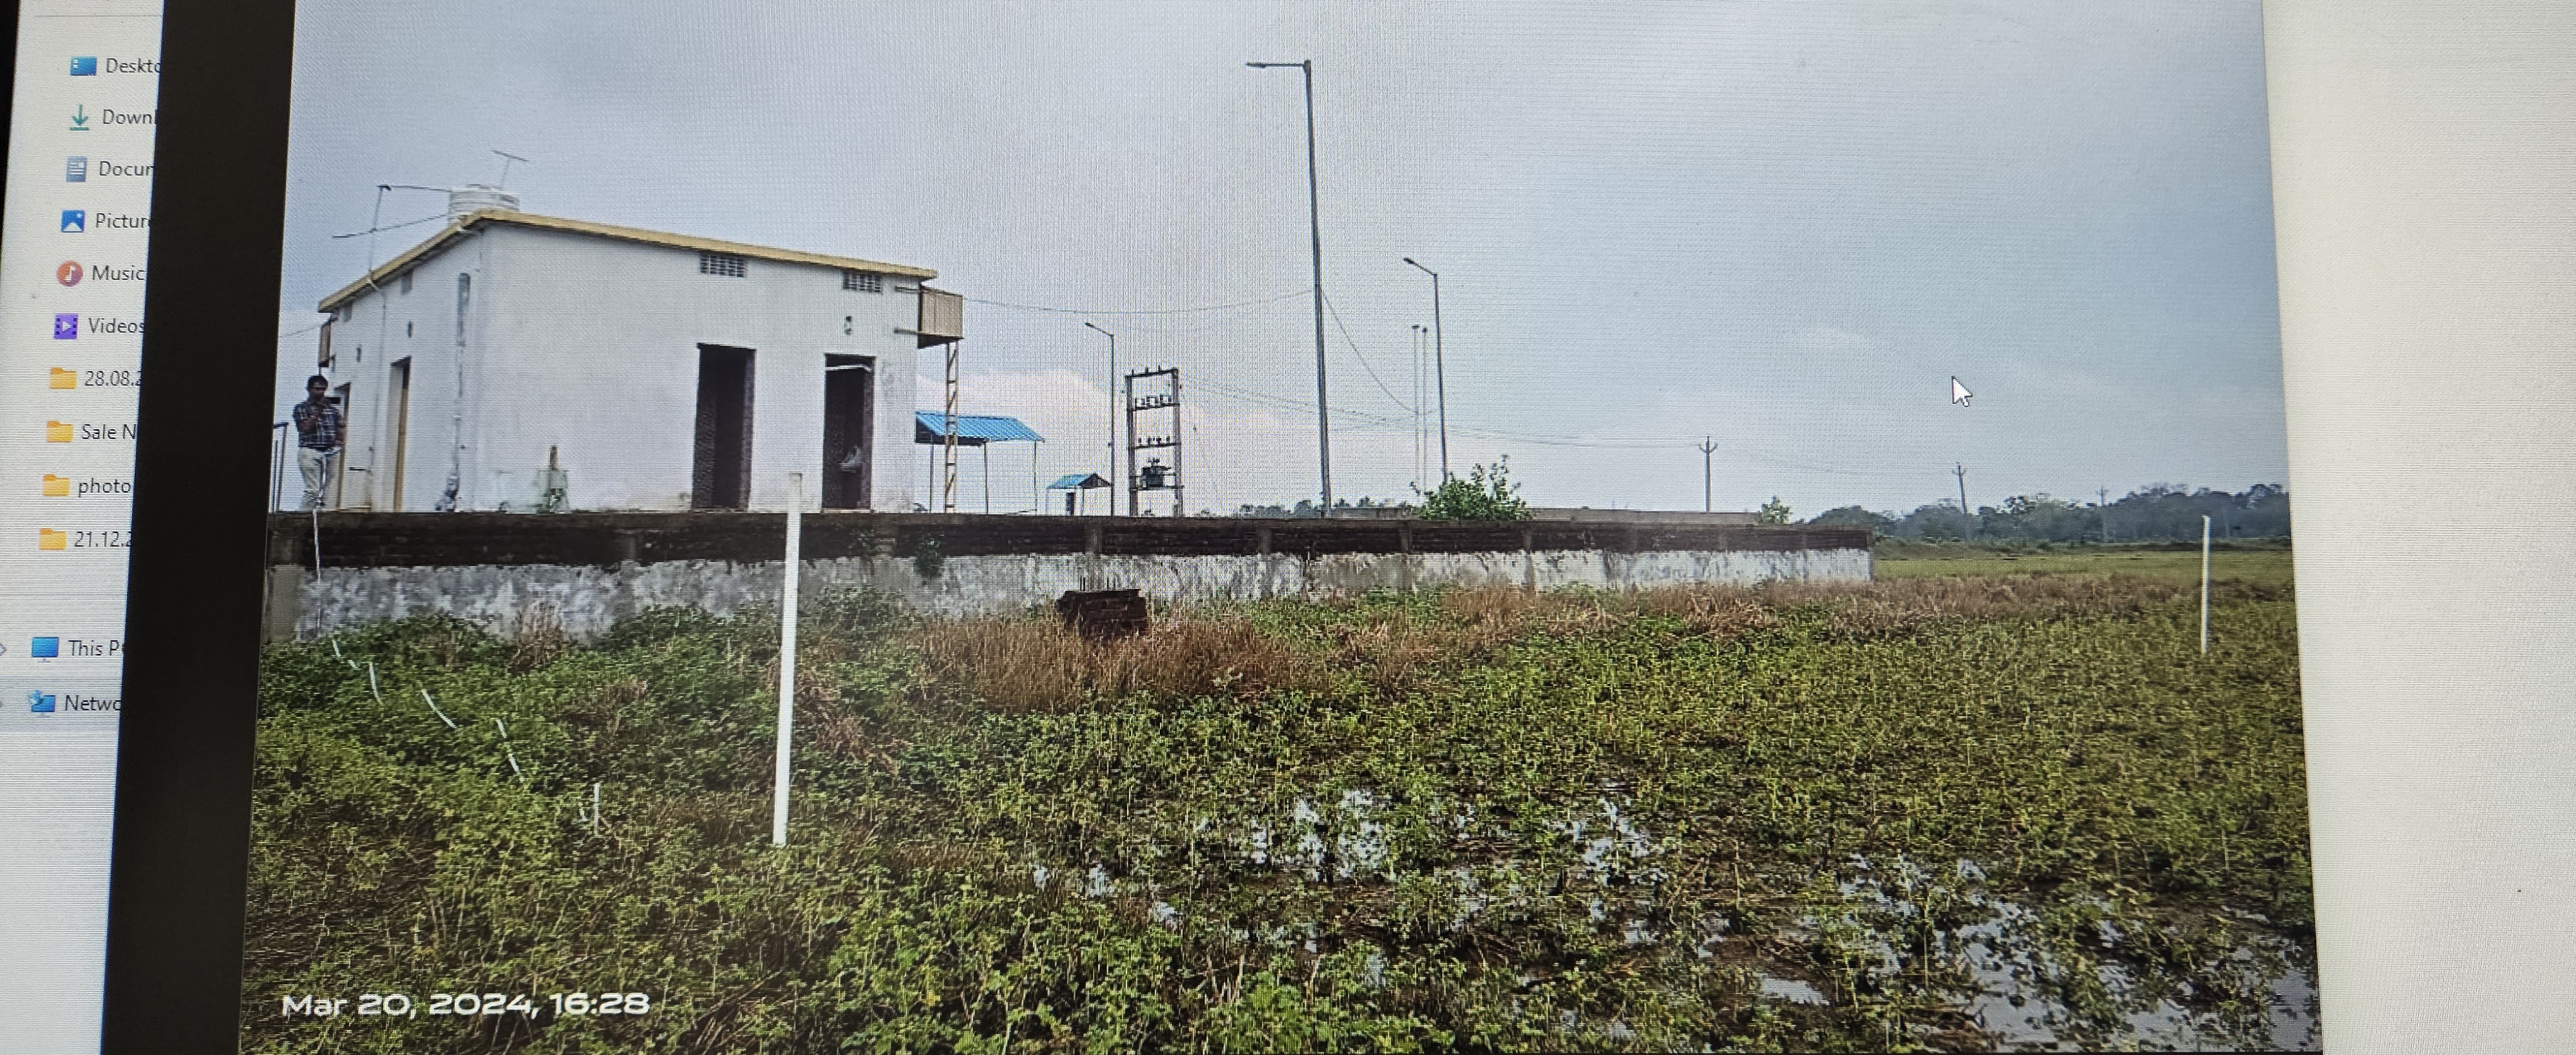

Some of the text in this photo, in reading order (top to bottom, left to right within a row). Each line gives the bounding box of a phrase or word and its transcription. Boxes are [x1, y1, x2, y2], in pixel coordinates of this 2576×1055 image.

[96, 213, 151, 228] Pictur
[92, 265, 146, 280] Music
[88, 318, 145, 333] Videos
[82, 424, 137, 439] Sale N
[79, 477, 131, 498] photo
[68, 640, 124, 656] This P
